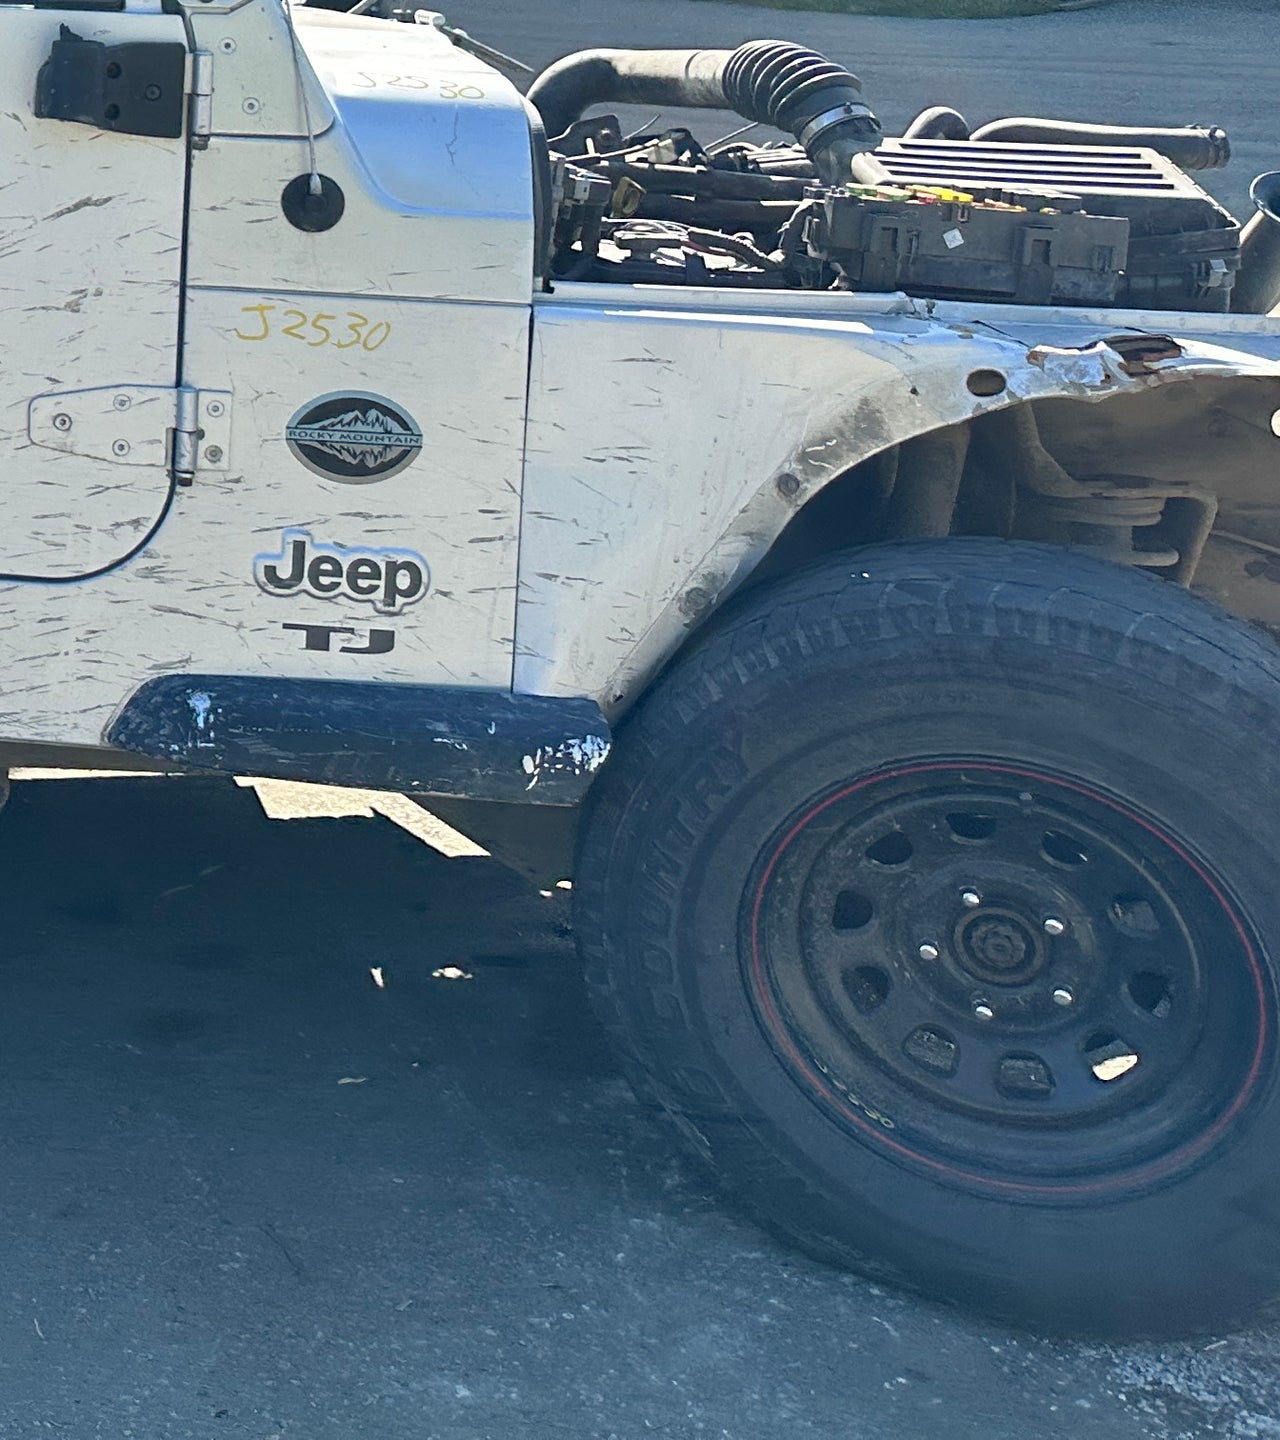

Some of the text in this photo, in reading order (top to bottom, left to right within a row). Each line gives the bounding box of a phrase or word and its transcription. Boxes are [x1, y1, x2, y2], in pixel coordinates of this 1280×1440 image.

[236, 303, 391, 351] J2530
[288, 430, 420, 445] ROCKY MOUNTAIN
[263, 539, 423, 608] Jeep
[281, 622, 396, 655] TJ
